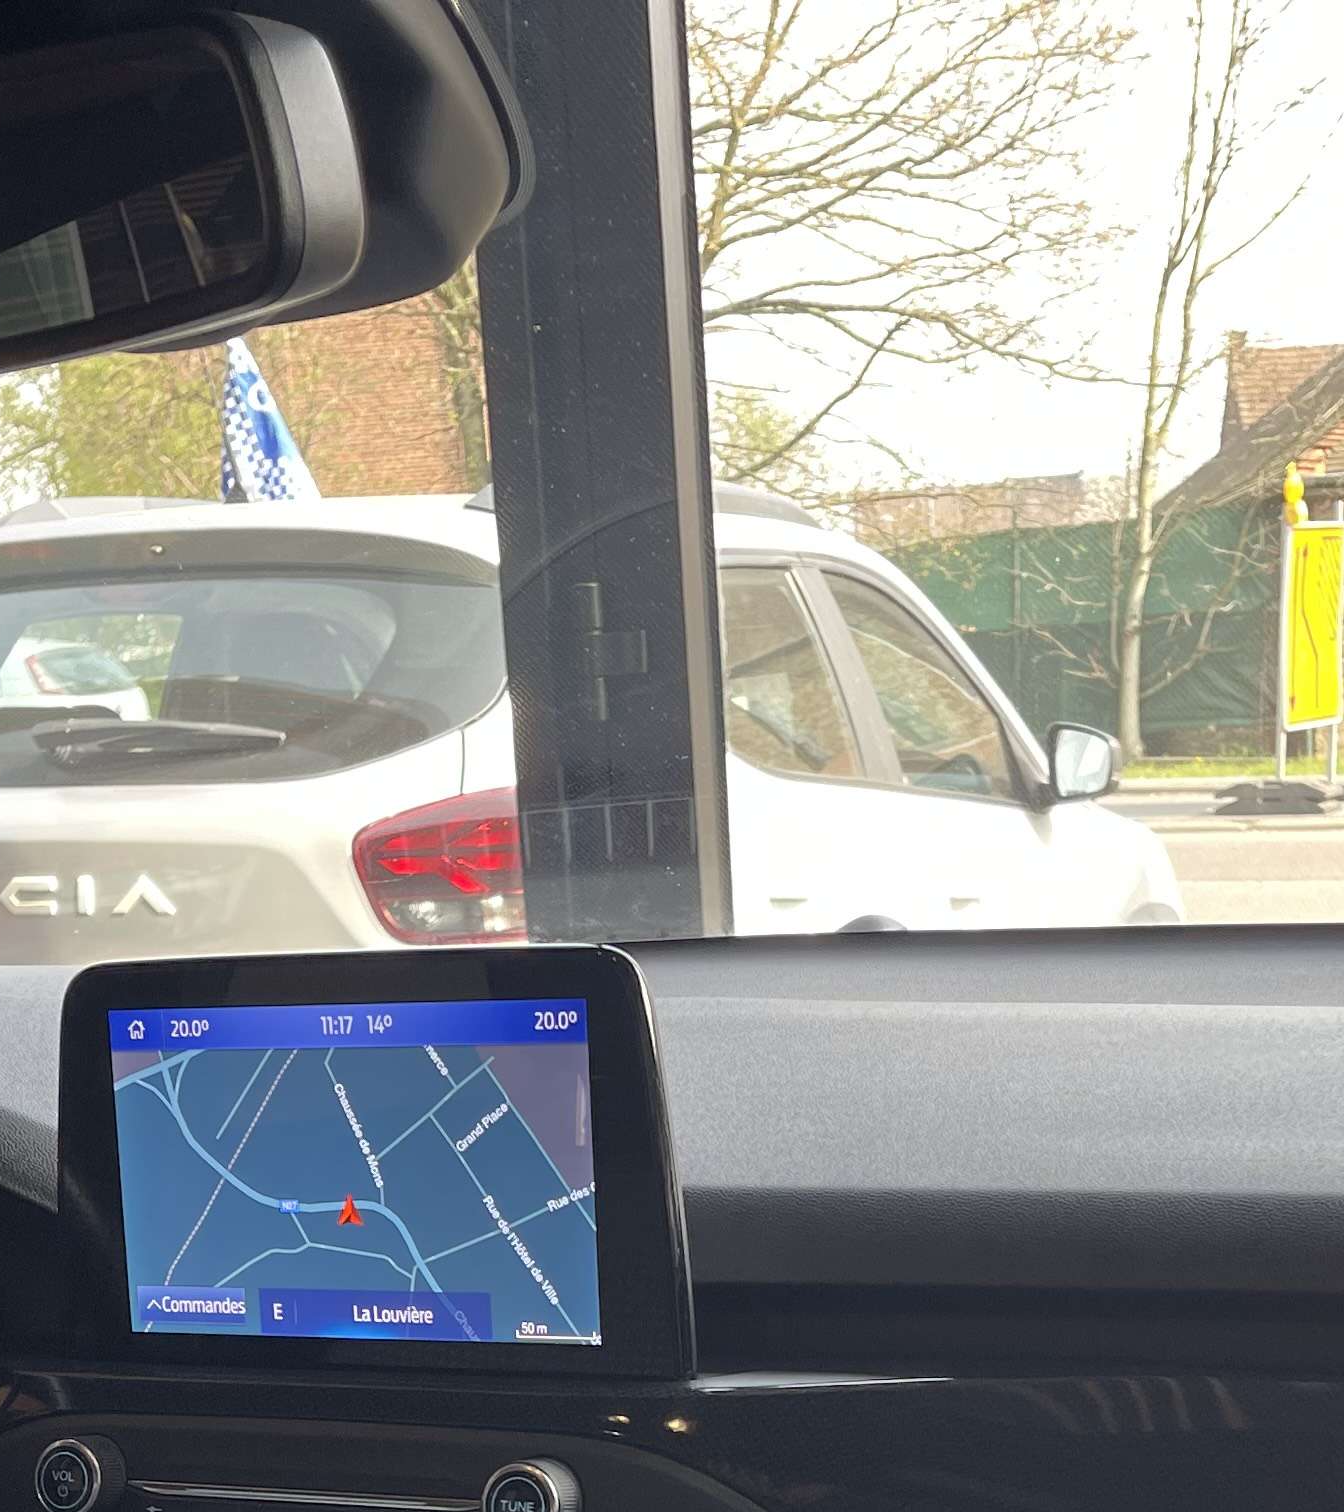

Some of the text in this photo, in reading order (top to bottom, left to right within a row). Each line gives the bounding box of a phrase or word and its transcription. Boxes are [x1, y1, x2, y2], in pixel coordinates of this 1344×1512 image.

[320, 1015, 354, 1036] 11:17
[456, 1103, 509, 1152] Grand Place
[367, 1153, 384, 1189] Mons
[547, 1198, 569, 1213] Rue
[570, 1187, 590, 1201] des
[482, 1195, 500, 1219] Rue
[498, 1219, 511, 1235] de
[530, 1266, 544, 1283] de
[541, 1280, 559, 1306] Ville
[161, 1296, 246, 1315] Commandes
[273, 1303, 284, 1320] E
[353, 1304, 434, 1324] La Louvière
[521, 1322, 548, 1334] 50 m
[52, 1470, 75, 1482] VOL
